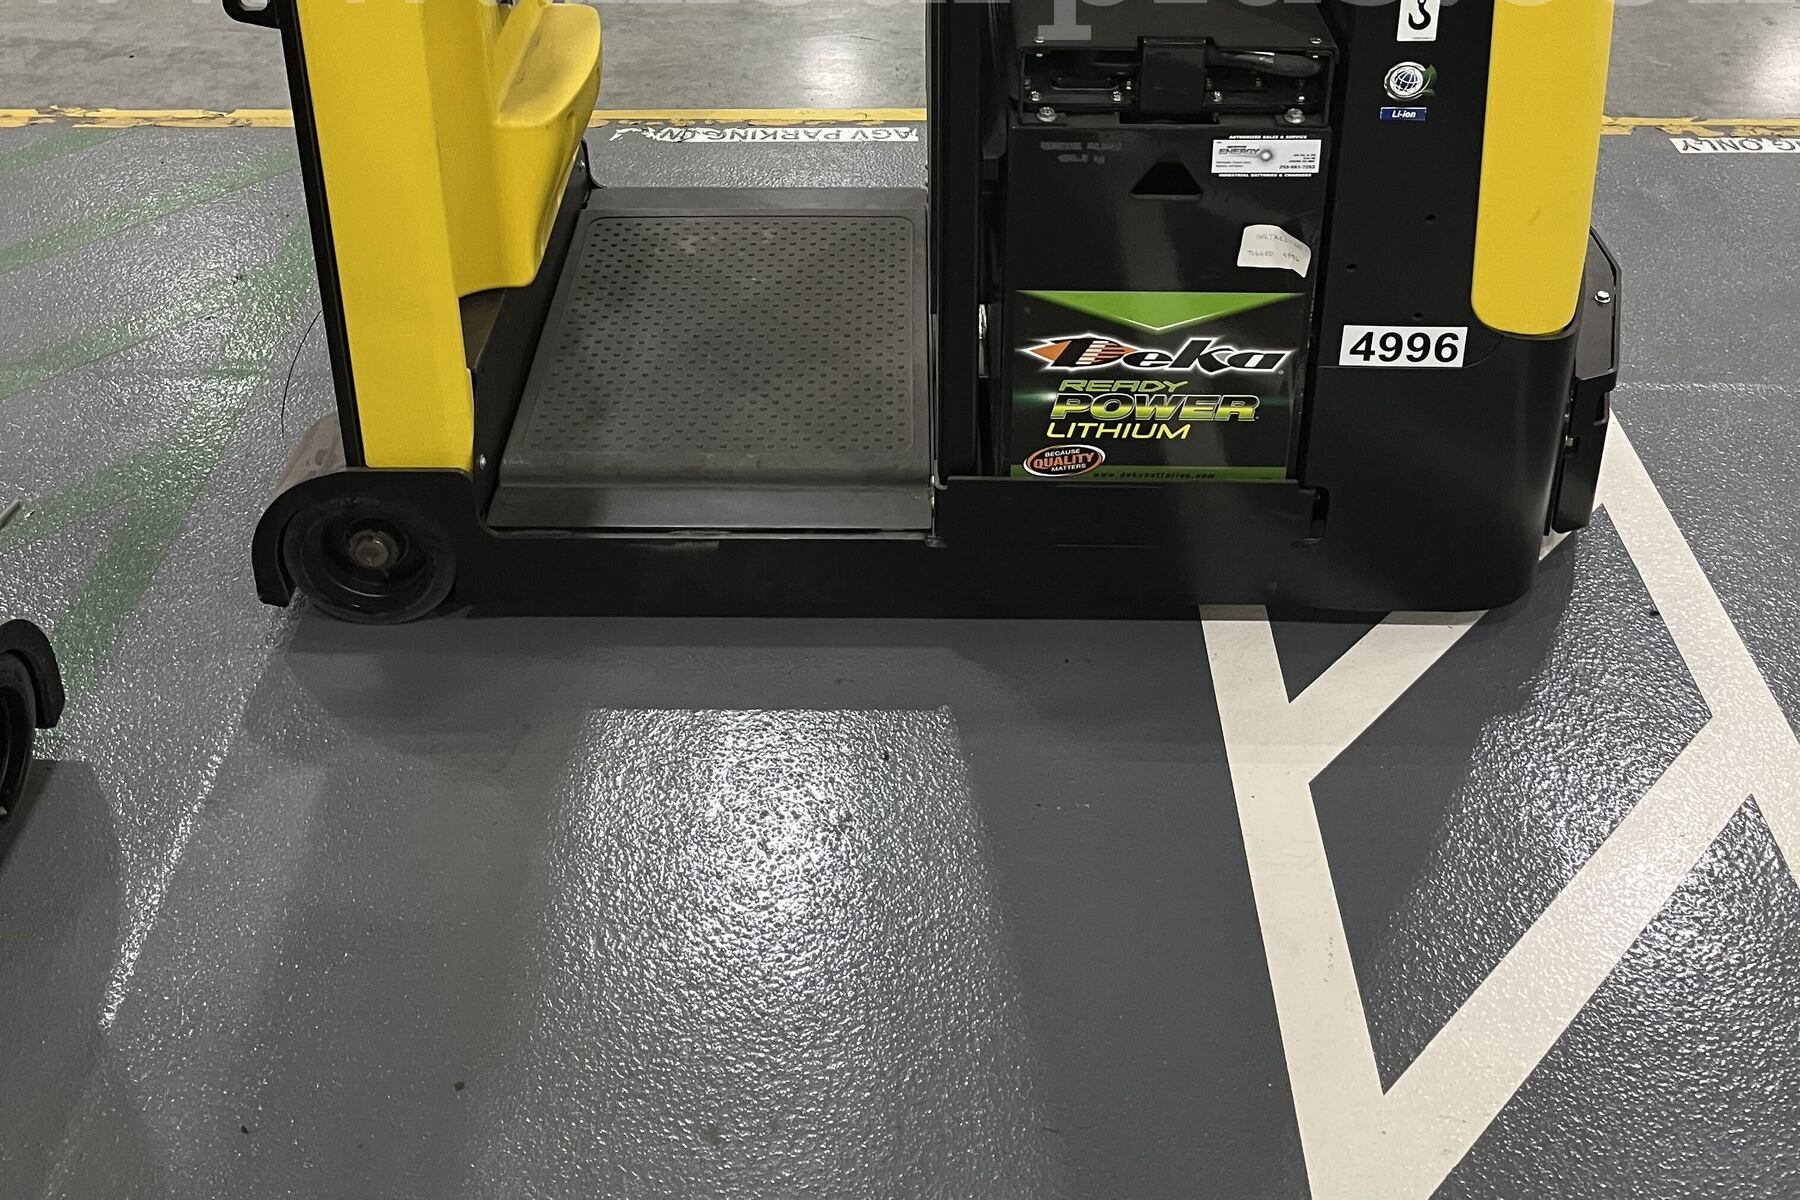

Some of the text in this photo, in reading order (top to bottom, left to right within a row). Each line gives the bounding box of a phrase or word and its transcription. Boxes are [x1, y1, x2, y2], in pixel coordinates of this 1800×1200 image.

[1391, 110, 1417, 119] Li-ion
[702, 128, 841, 142] PARKING
[850, 128, 914, 141] AGV
[1682, 139, 1764, 151] ONLY
[1349, 331, 1460, 363] 4996
[1020, 335, 1288, 374] Deka
[1058, 379, 1189, 393] READY
[1050, 392, 1260, 422] POWER
[1046, 422, 1191, 440] LITHIUM
[1044, 448, 1081, 458] BECAUSE
[1033, 452, 1095, 470] QUALITY
[1051, 462, 1087, 472] MATTERS
